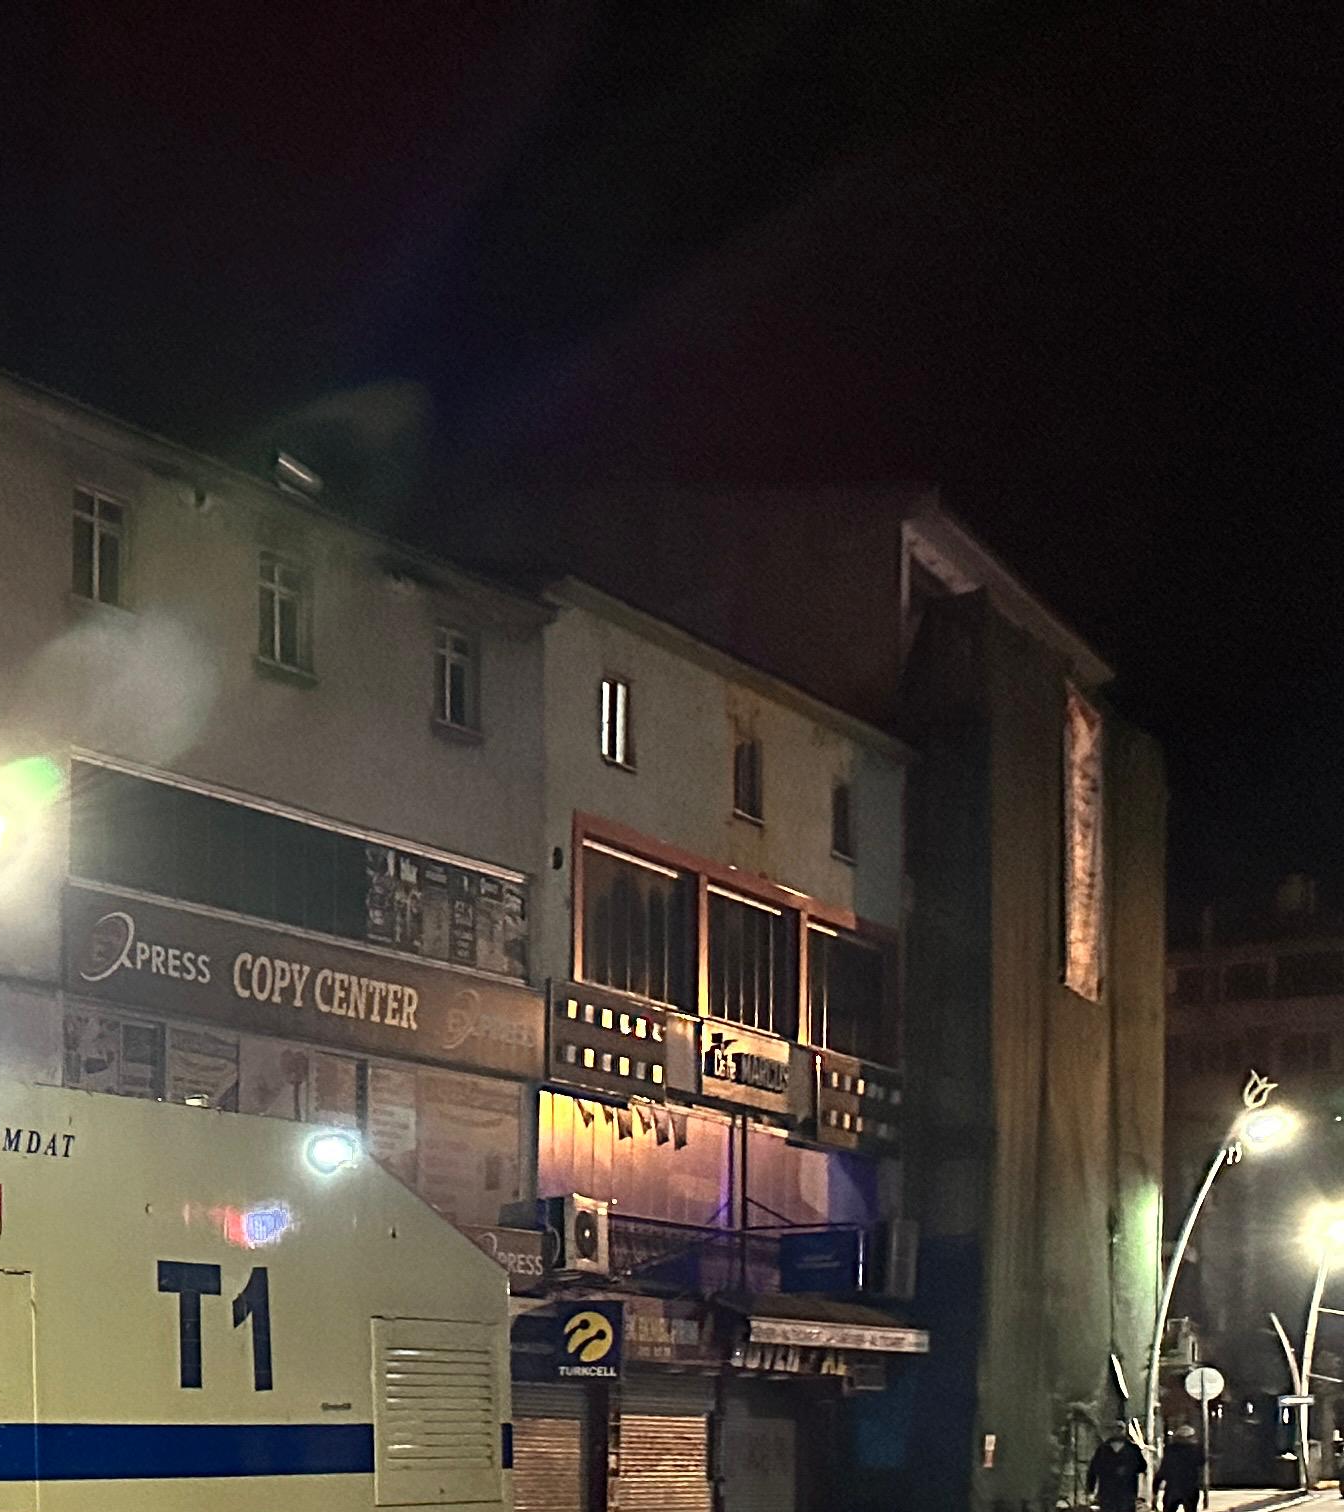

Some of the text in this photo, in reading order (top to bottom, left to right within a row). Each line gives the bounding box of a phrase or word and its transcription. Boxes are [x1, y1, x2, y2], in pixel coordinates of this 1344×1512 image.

[234, 952, 311, 1007] COPY
[315, 969, 418, 1030] CENTER
[157, 1260, 273, 1391] T1
[558, 1365, 617, 1377] TURKCELL
